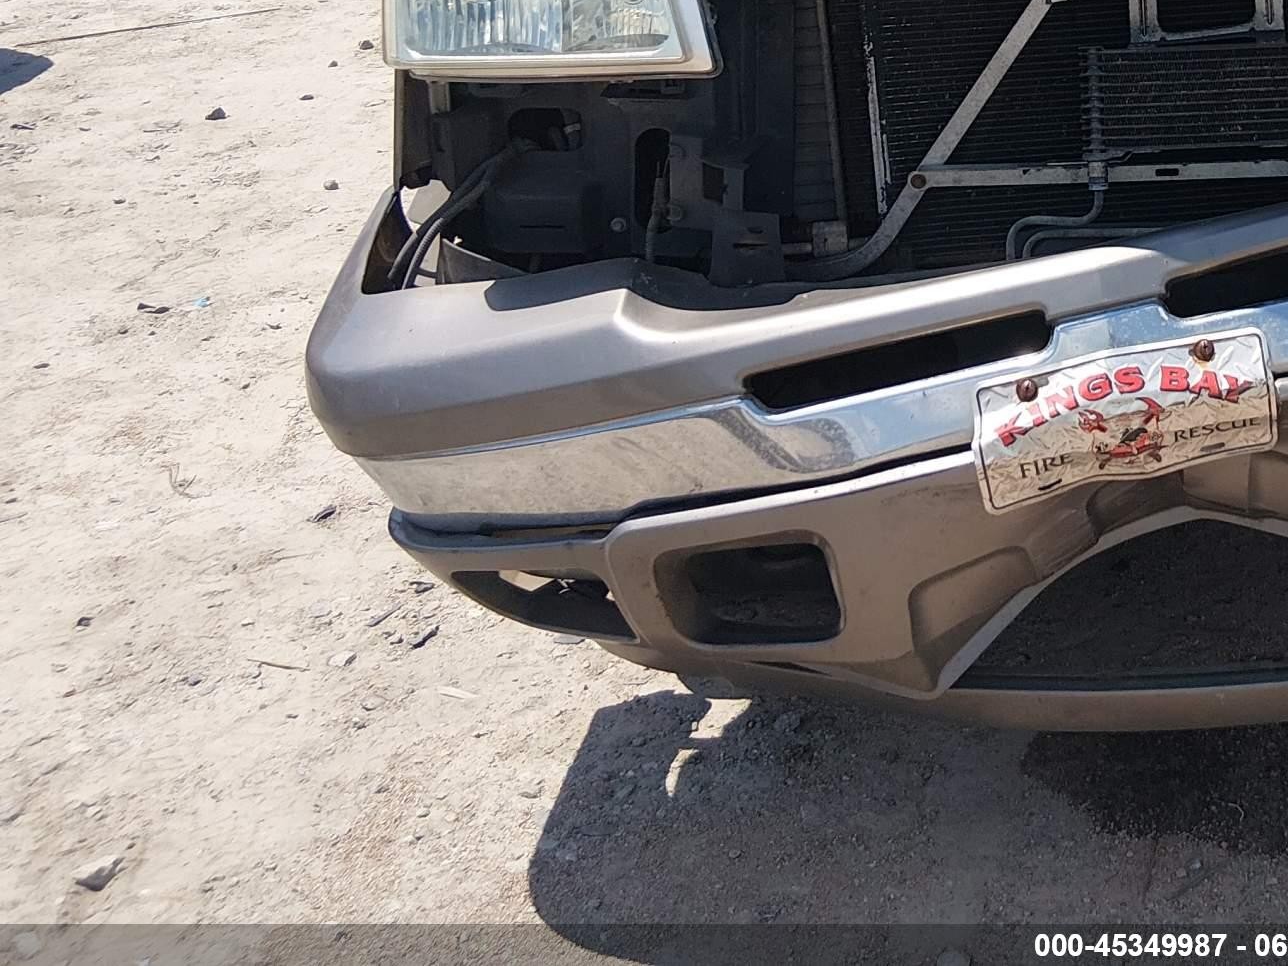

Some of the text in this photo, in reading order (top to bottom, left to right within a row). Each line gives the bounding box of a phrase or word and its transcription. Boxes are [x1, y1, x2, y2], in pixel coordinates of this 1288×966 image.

[996, 366, 1252, 447] KINGS BAY
[1021, 417, 1261, 478] FIRE RESCUE
